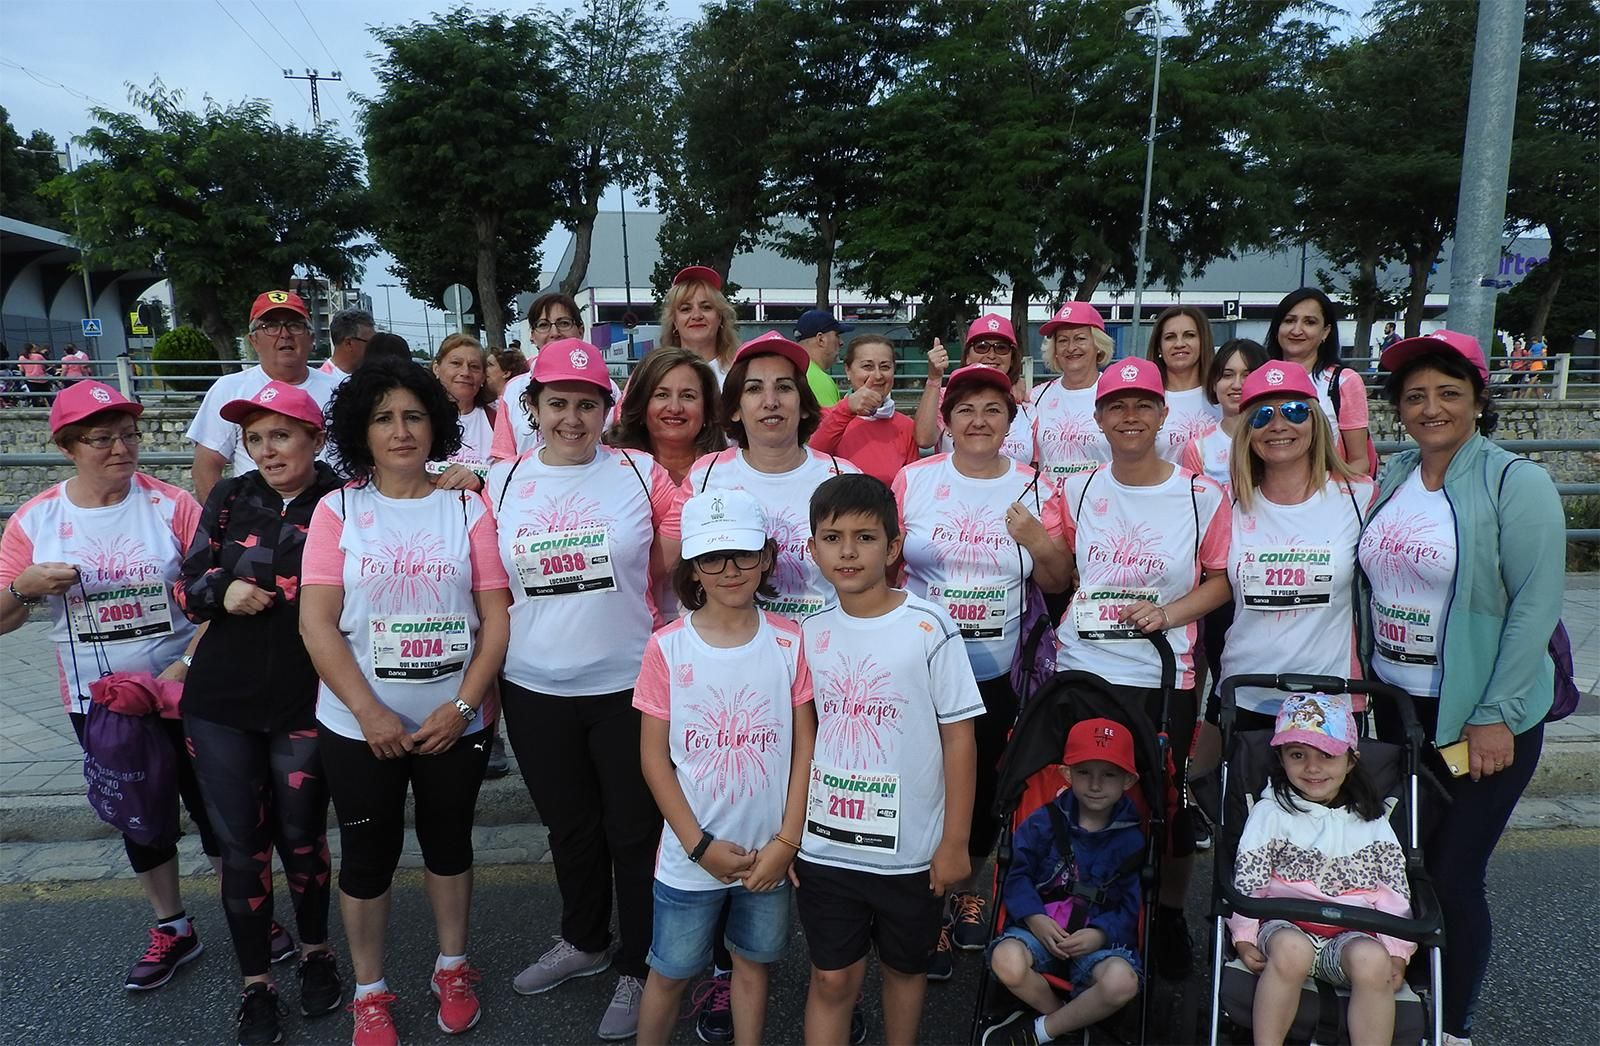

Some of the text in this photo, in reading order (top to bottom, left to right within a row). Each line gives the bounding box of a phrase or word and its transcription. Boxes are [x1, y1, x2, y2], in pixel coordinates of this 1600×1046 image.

[1227, 301, 1236, 315] P
[530, 534, 605, 553] COVIRAN
[932, 527, 1012, 550] Por ti mujer
[1087, 545, 1166, 574] Por ti mujer
[1258, 553, 1331, 563] COVIRAN
[1394, 543, 1442, 563] mujer
[360, 556, 458, 582] Por ti mujer
[540, 553, 586, 576] 2038
[1265, 568, 1306, 586] 2128
[86, 586, 163, 602] COVIRAN
[943, 589, 1006, 599] COVIRAN
[1091, 591, 1160, 604] COVIRAN
[99, 602, 144, 623] 2091
[759, 602, 823, 613] OVIRAN
[948, 604, 987, 621] 2082
[391, 620, 466, 633] COVIRAN
[1379, 619, 1406, 643] 2107
[400, 639, 444, 658] 2074
[853, 701, 899, 726] mujer
[685, 729, 712, 752] Por
[736, 728, 778, 752] mujer
[822, 774, 897, 794] COVIRAN
[829, 794, 865, 820] 2117
